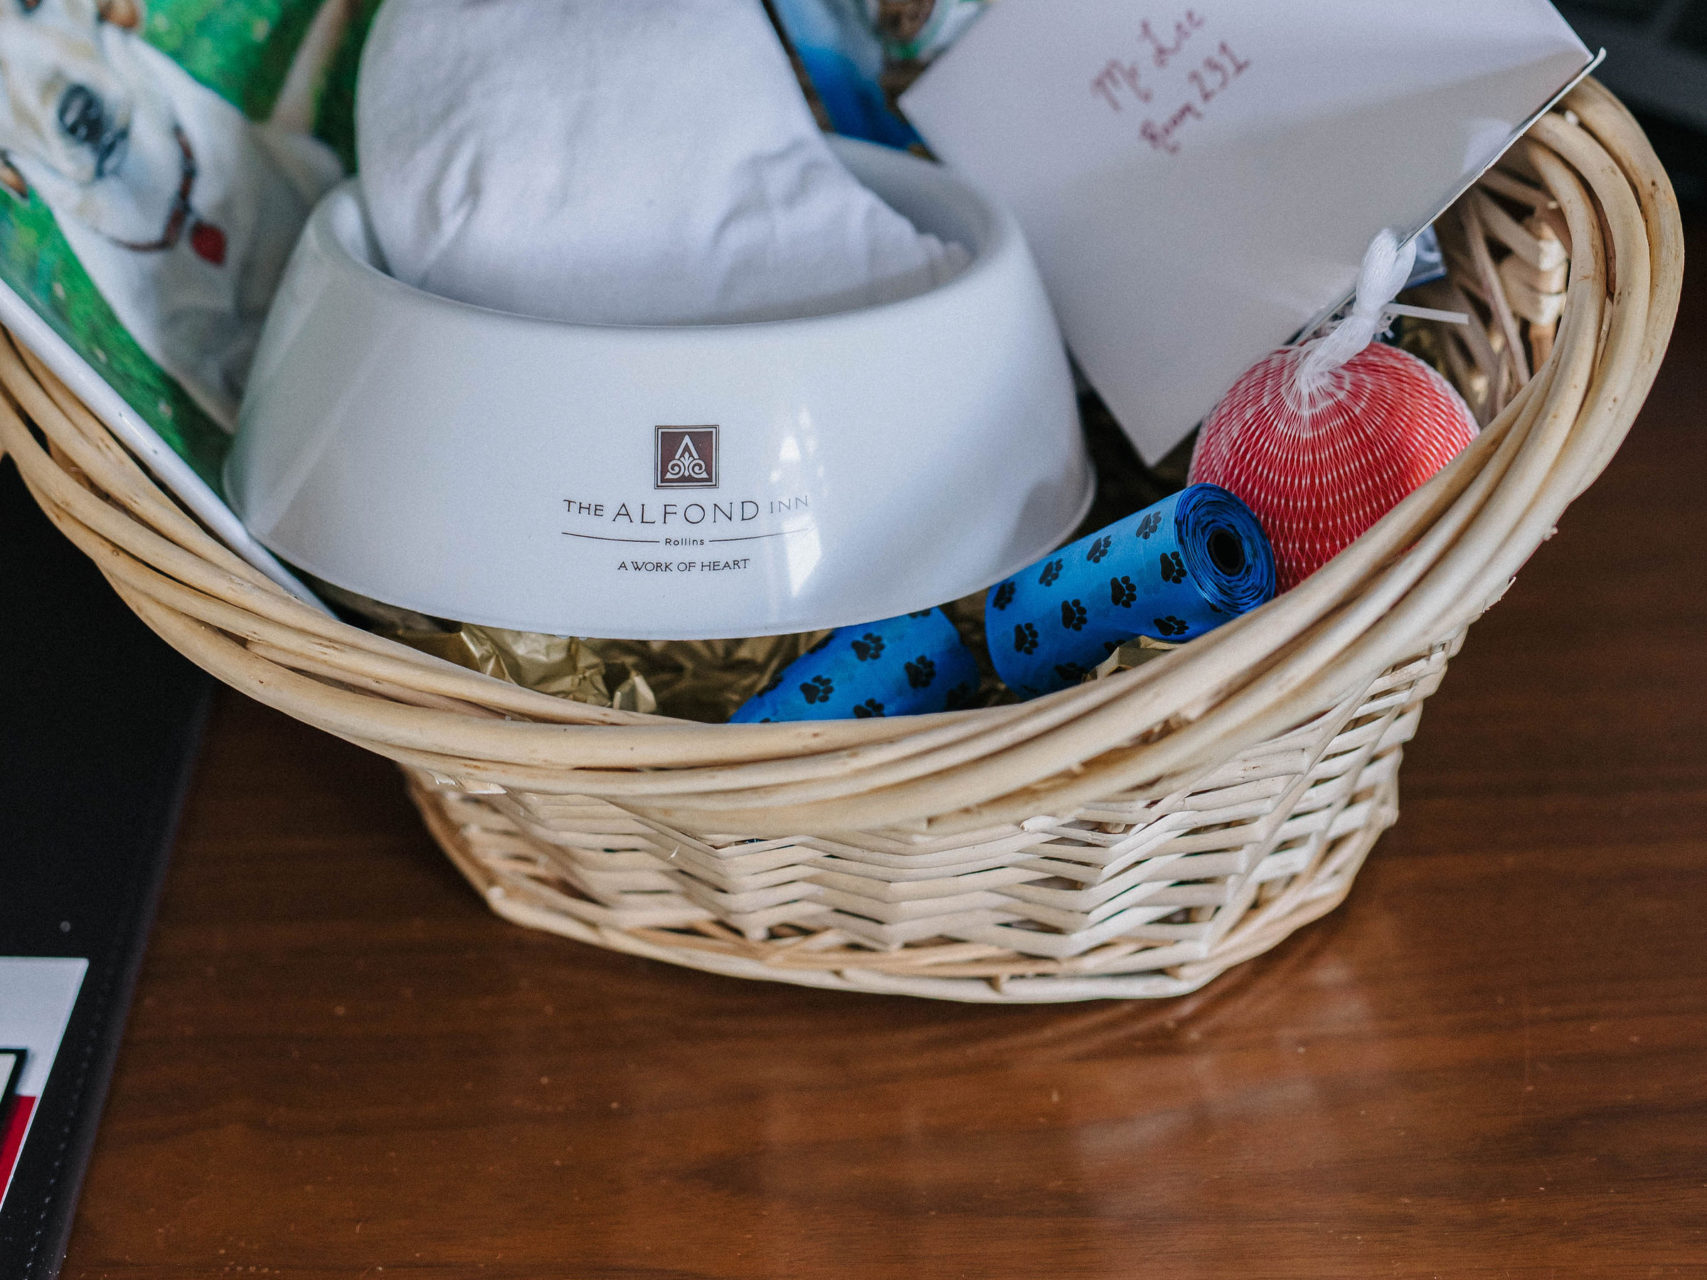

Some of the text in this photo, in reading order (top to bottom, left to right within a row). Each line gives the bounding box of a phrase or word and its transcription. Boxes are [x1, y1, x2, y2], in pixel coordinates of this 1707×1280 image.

[1187, 40, 1252, 103] 231
[563, 495, 809, 525] THE ALFOND INN
[664, 537, 705, 546] Rollins
[617, 558, 750, 572] A WORK OF HEART
